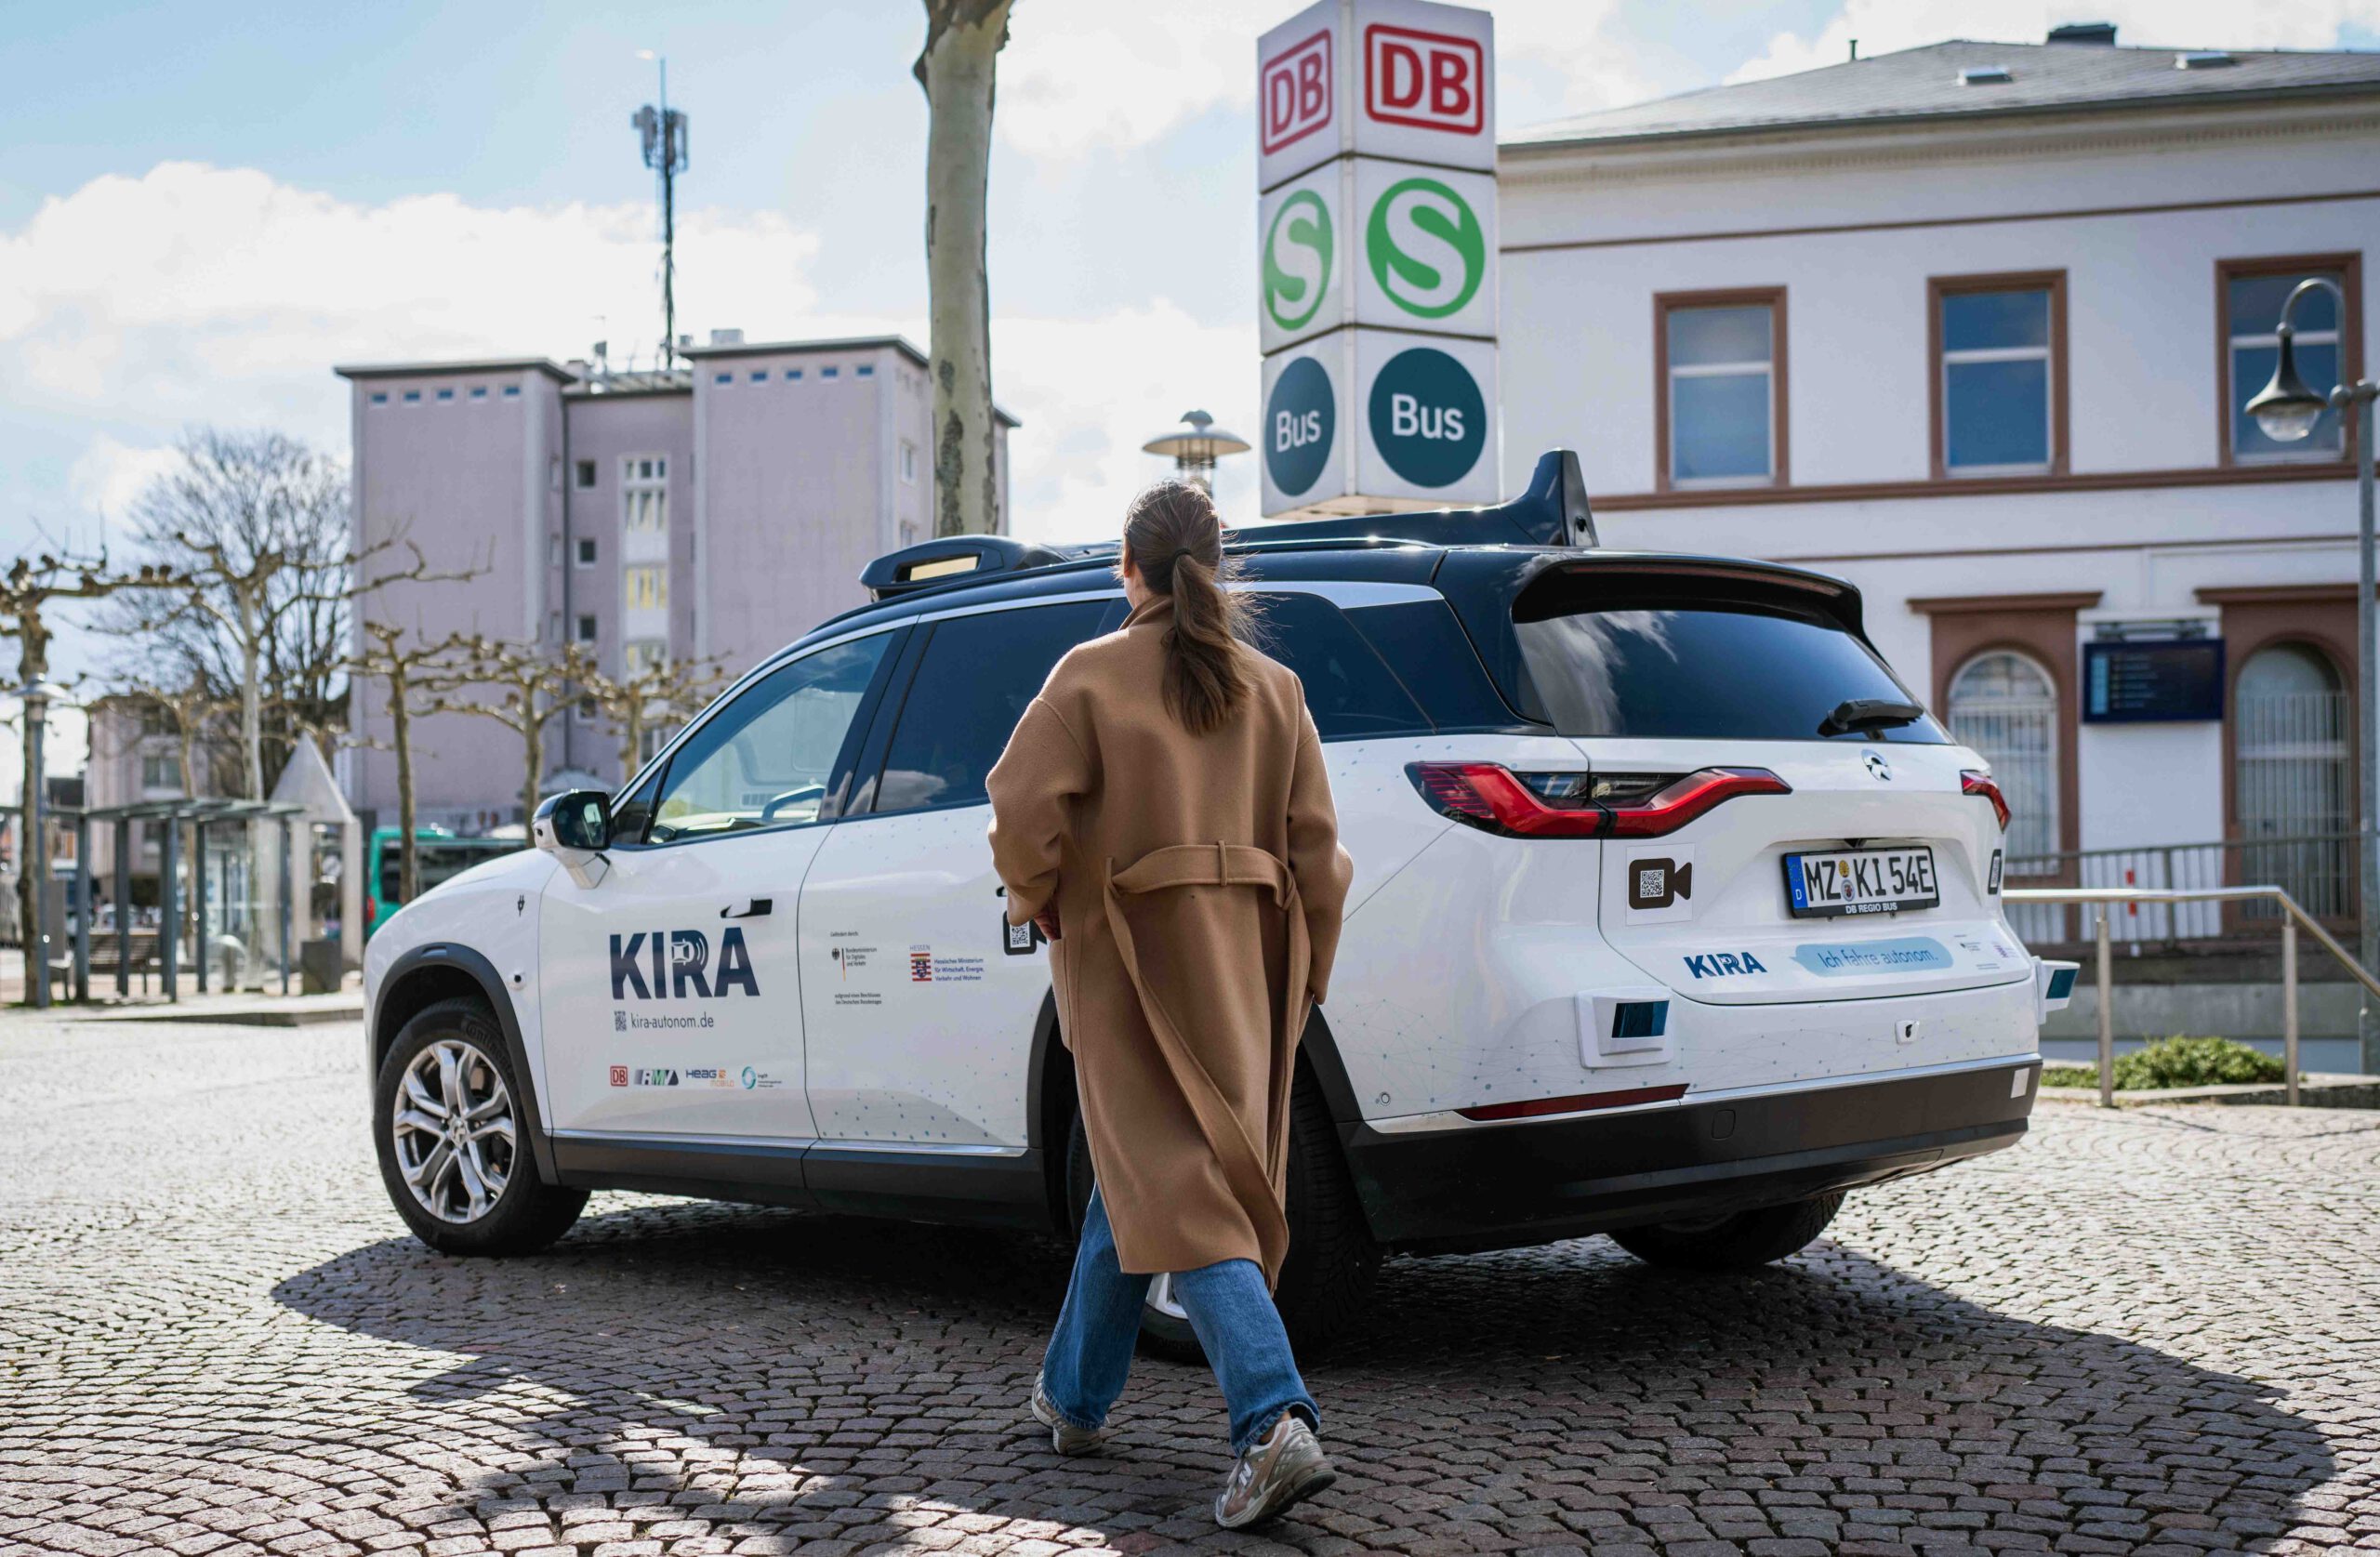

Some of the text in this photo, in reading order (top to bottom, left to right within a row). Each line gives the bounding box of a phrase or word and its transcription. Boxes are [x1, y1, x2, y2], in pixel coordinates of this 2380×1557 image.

[1270, 50, 1324, 138] DB
[1380, 41, 1471, 118] DB
[1272, 201, 1324, 323] S
[1385, 187, 1468, 310] S
[1276, 408, 1322, 454] Bus
[1391, 392, 1466, 442] Bus
[1795, 889, 1803, 901] D
[1804, 855, 1935, 902] MZ KI 54E
[1845, 902, 1897, 914] DB REGIO BUS
[609, 927, 760, 1000] KIRA
[1683, 951, 1768, 979] KIRA
[1818, 948, 1938, 968] Ich fahre autonom.
[630, 1010, 714, 1029] kira-autonom.de
[612, 1069, 627, 1084] DB
